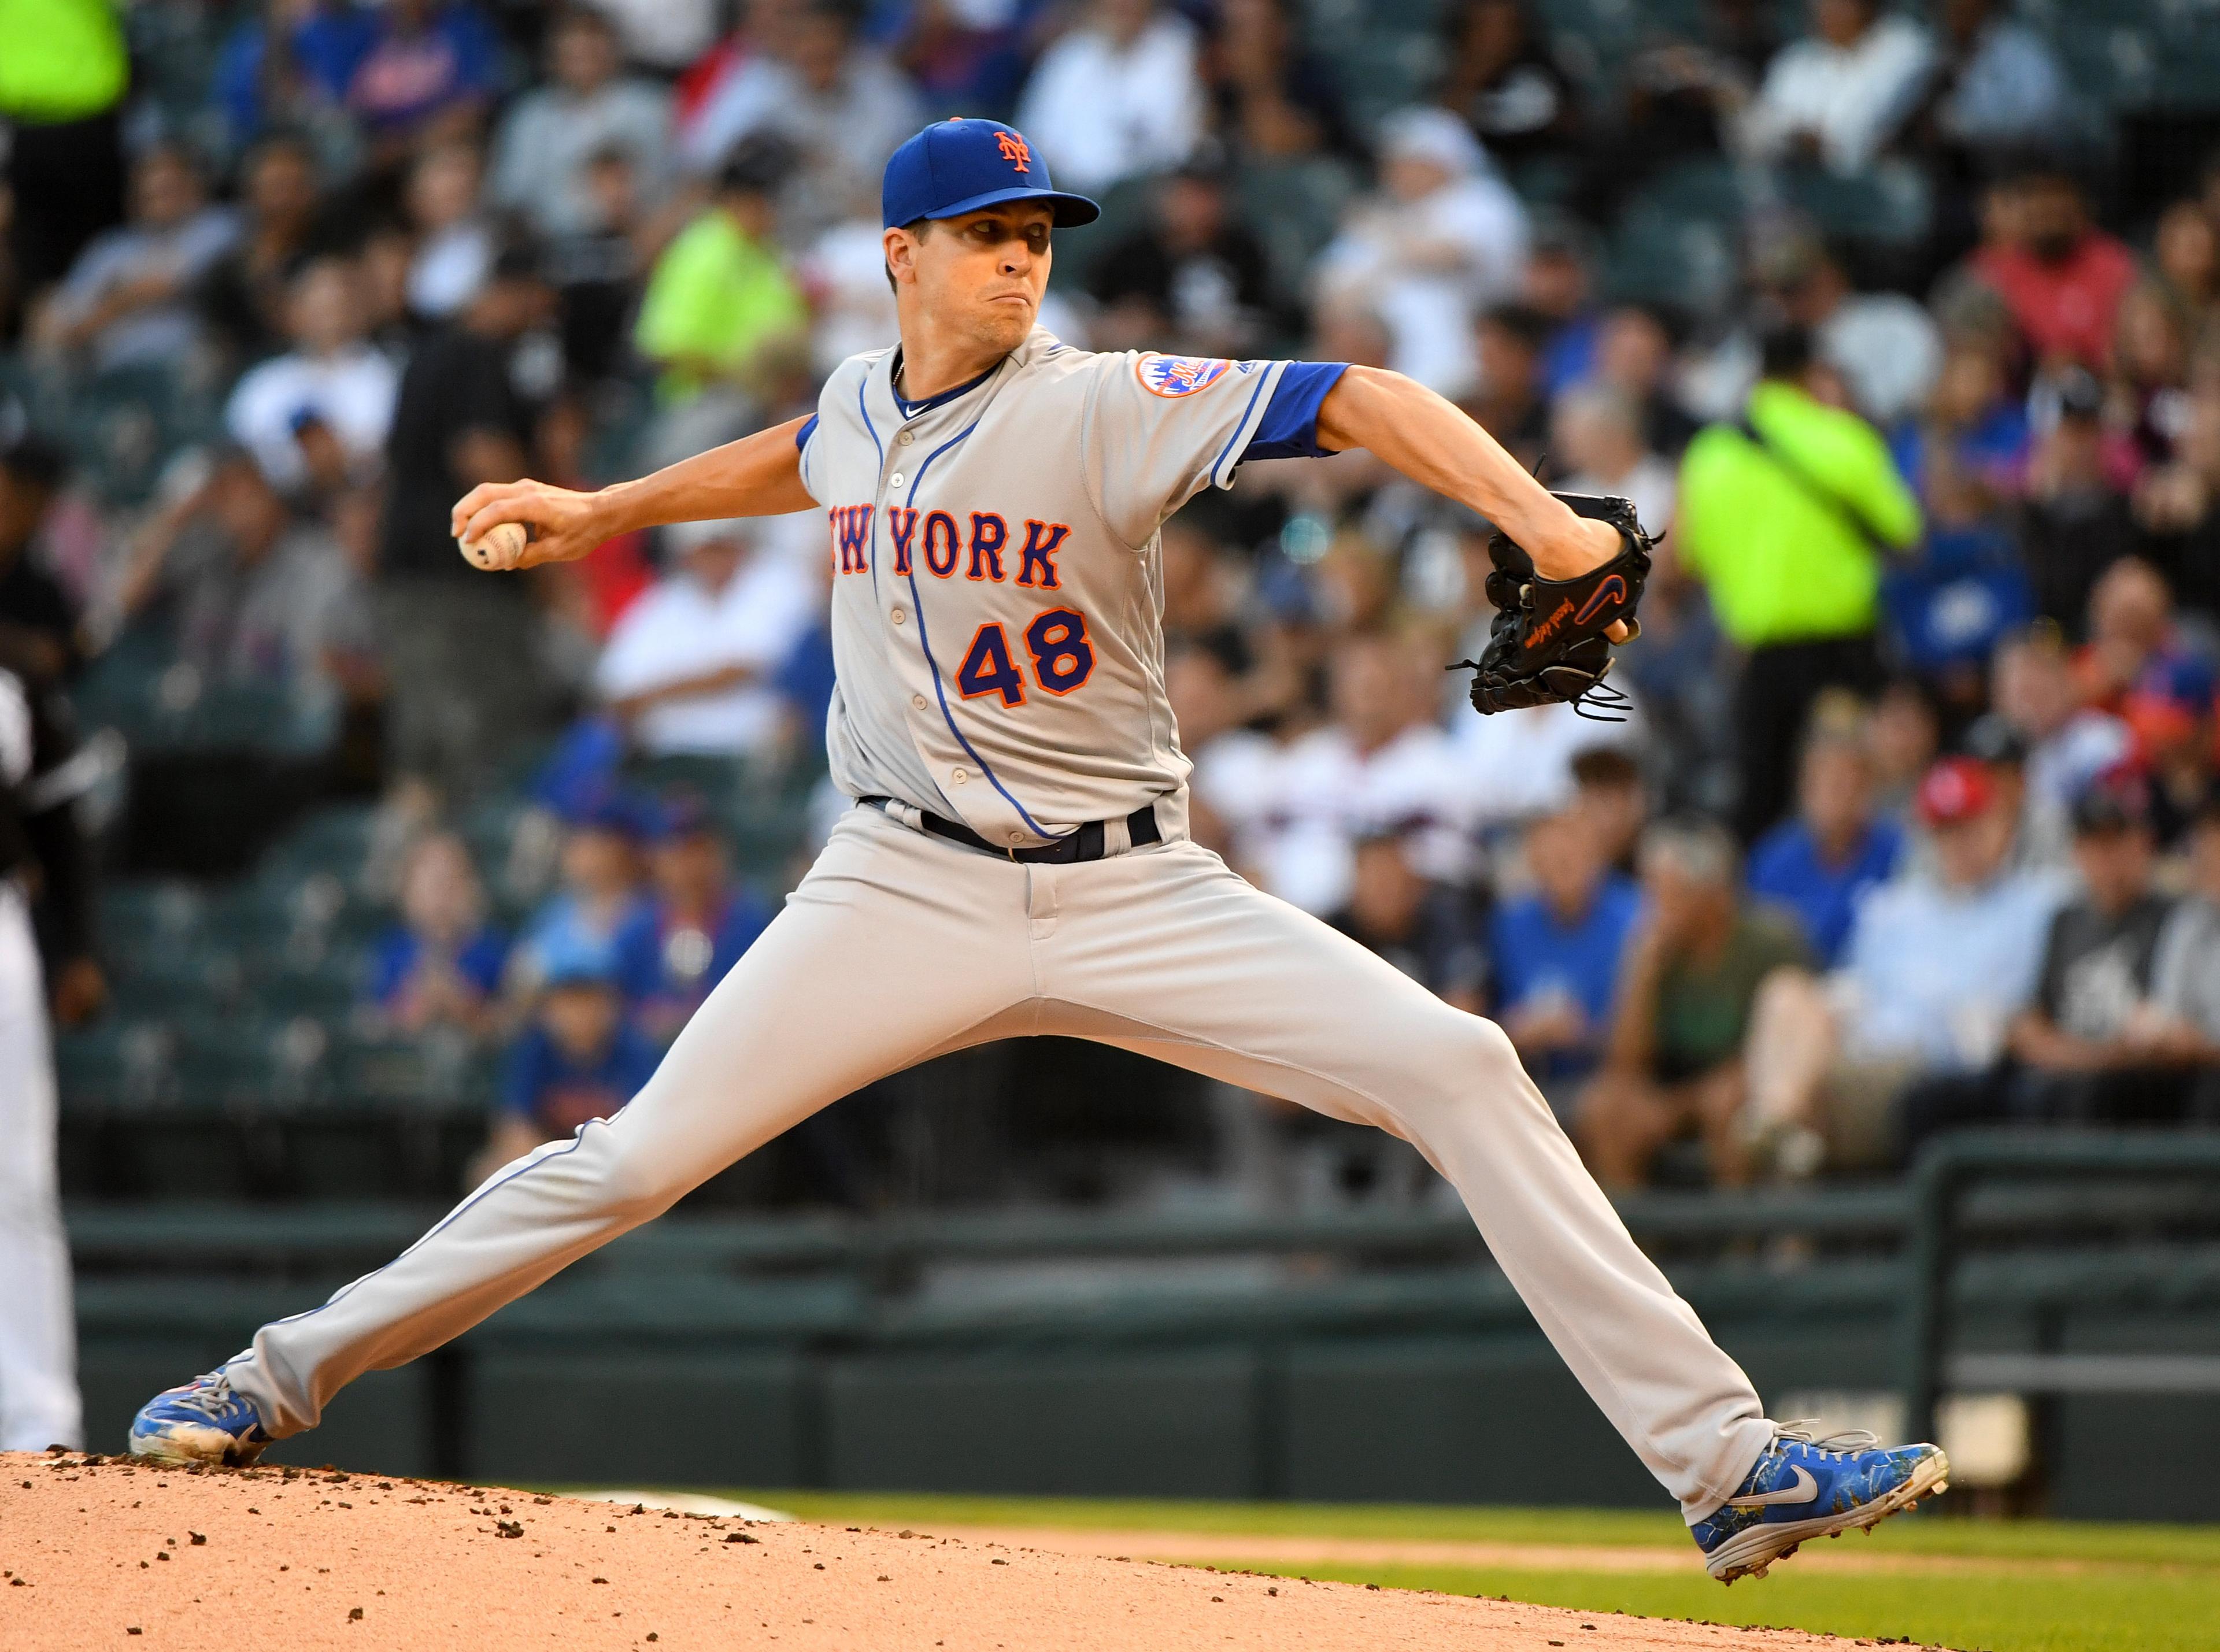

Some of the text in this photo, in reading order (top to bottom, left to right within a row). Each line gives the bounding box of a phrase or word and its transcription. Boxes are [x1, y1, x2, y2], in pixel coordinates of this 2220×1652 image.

[993, 131, 1031, 173] NY
[889, 505, 1072, 590] YORK
[954, 606, 1097, 709] 48
